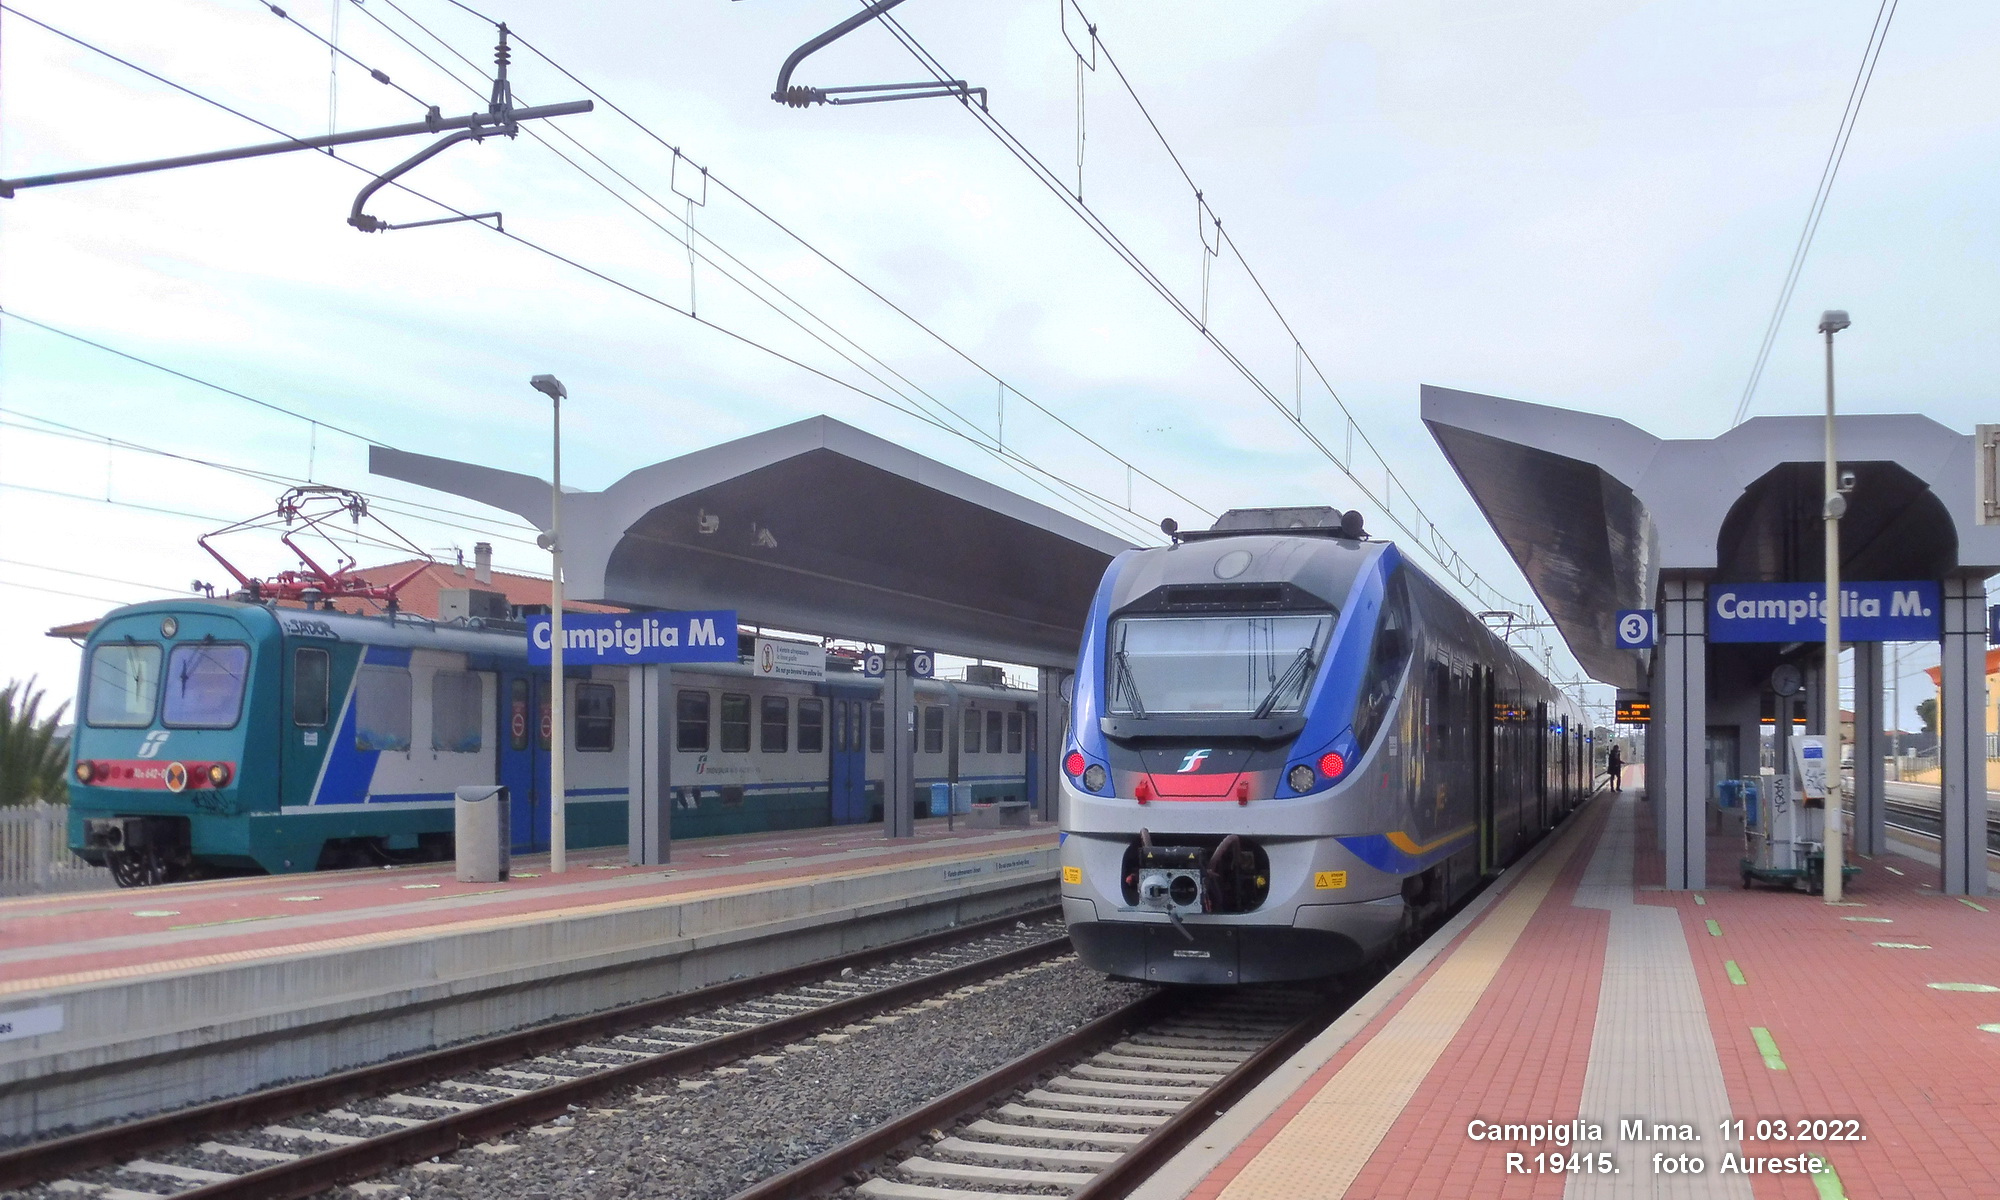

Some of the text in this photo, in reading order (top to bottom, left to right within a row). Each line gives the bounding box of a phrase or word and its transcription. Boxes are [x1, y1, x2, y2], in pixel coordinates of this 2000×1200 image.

[1890, 590, 1932, 617] M.
[687, 618, 726, 647] M.
[1626, 618, 1641, 639] 3
[870, 658, 879, 671] 5
[918, 658, 928, 671] 4
